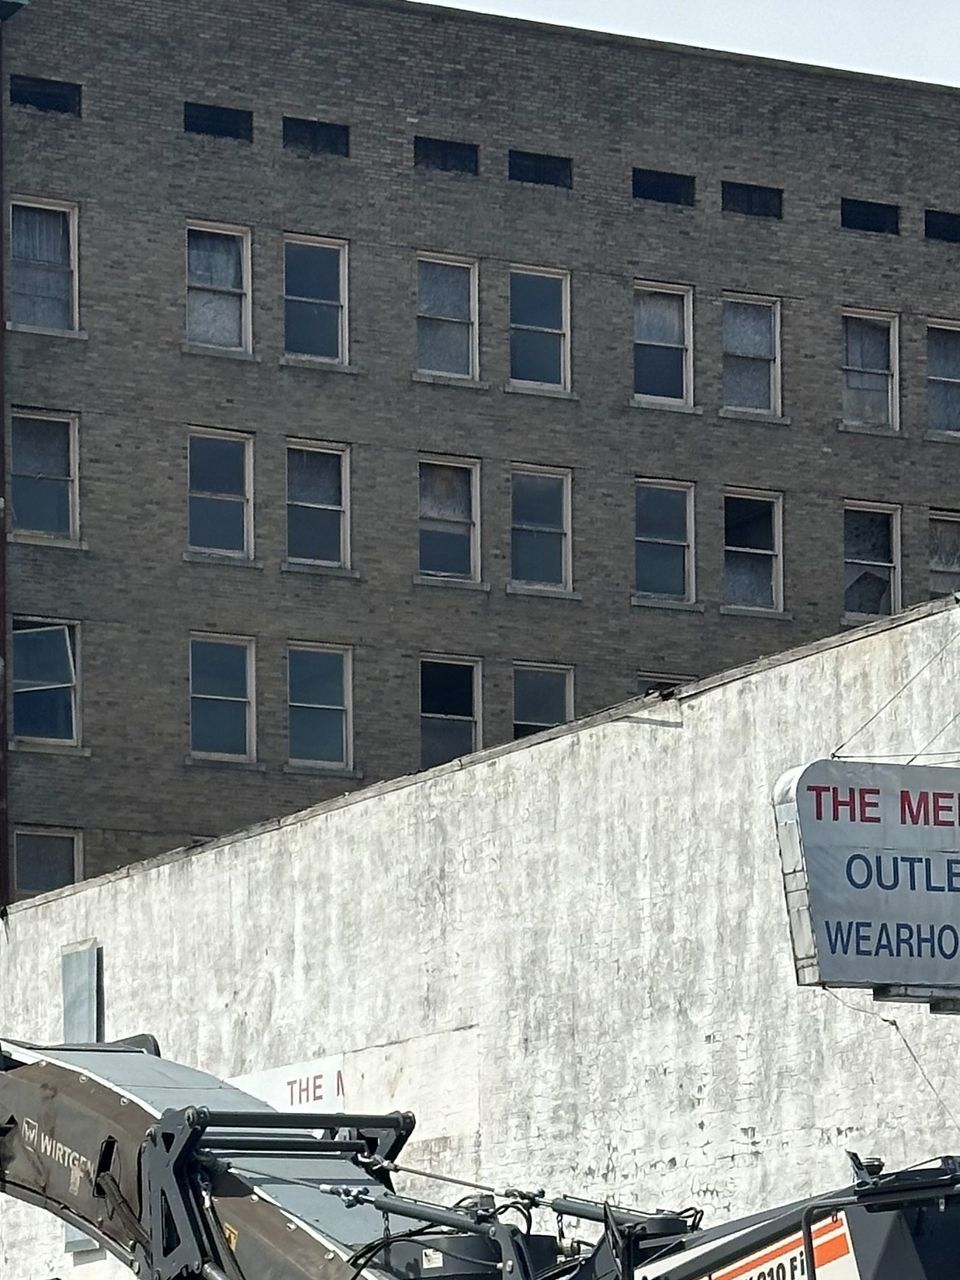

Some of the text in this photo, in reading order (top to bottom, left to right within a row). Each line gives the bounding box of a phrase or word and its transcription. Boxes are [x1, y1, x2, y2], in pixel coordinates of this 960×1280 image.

[806, 785, 960, 827] THE ME
[845, 853, 960, 893] OUTLE
[824, 920, 960, 960] WEARHO
[286, 1074, 324, 1106] THE
[41, 1132, 95, 1179] WIRTGEN
[790, 1250, 805, 1280] Fi
